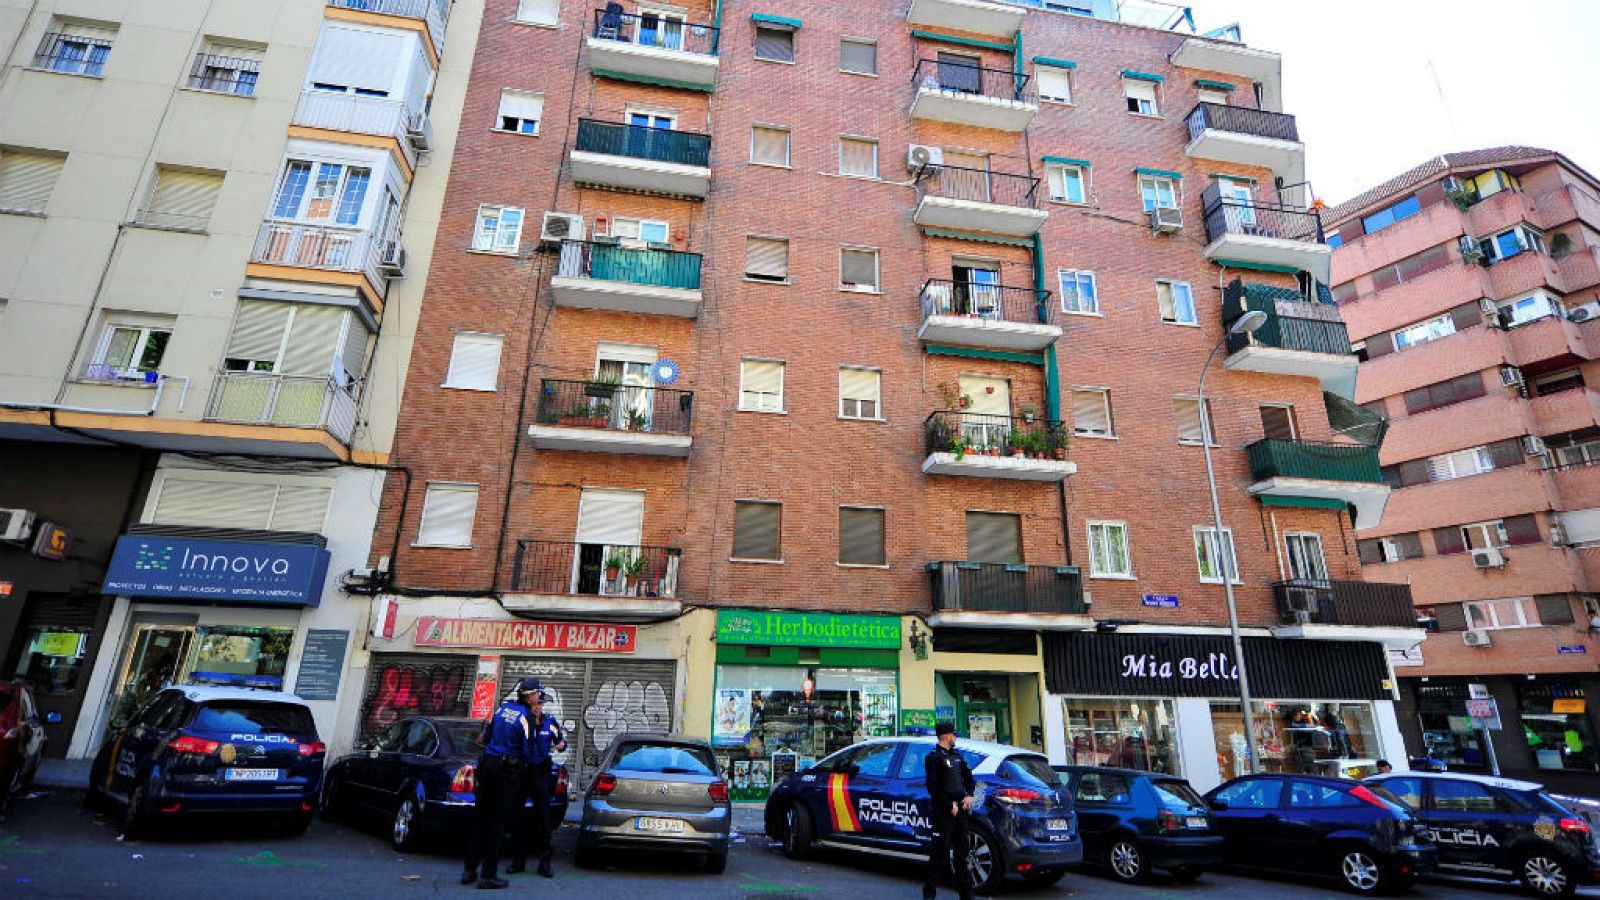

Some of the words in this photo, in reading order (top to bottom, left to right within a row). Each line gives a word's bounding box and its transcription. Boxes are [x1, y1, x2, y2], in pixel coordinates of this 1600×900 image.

[181, 547, 289, 575] Innova
[440, 619, 547, 647] ALIMENTACION
[553, 624, 565, 647] Y
[567, 626, 616, 649] BAZAR
[765, 615, 899, 639] Herbodietética
[1121, 654, 1173, 679] Mia
[858, 811, 933, 829] NACIONAL
